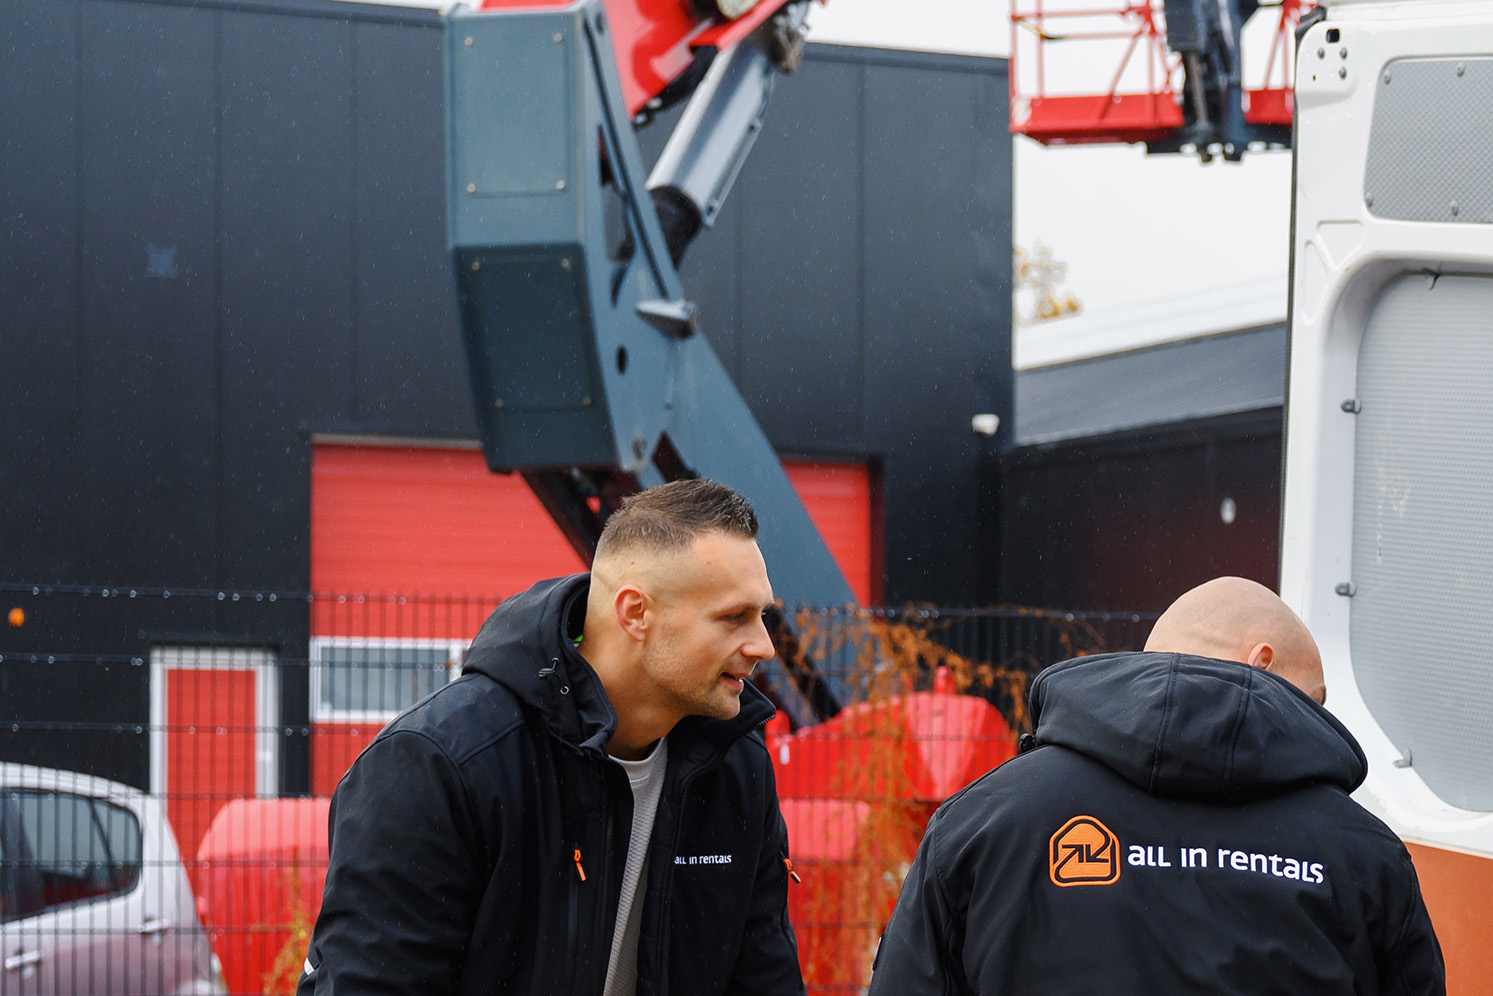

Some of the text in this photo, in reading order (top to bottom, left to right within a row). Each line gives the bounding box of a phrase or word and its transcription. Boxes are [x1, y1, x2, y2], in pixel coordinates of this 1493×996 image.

[674, 855, 732, 864] all in rentals
[1127, 845, 1324, 884] all in rentals
